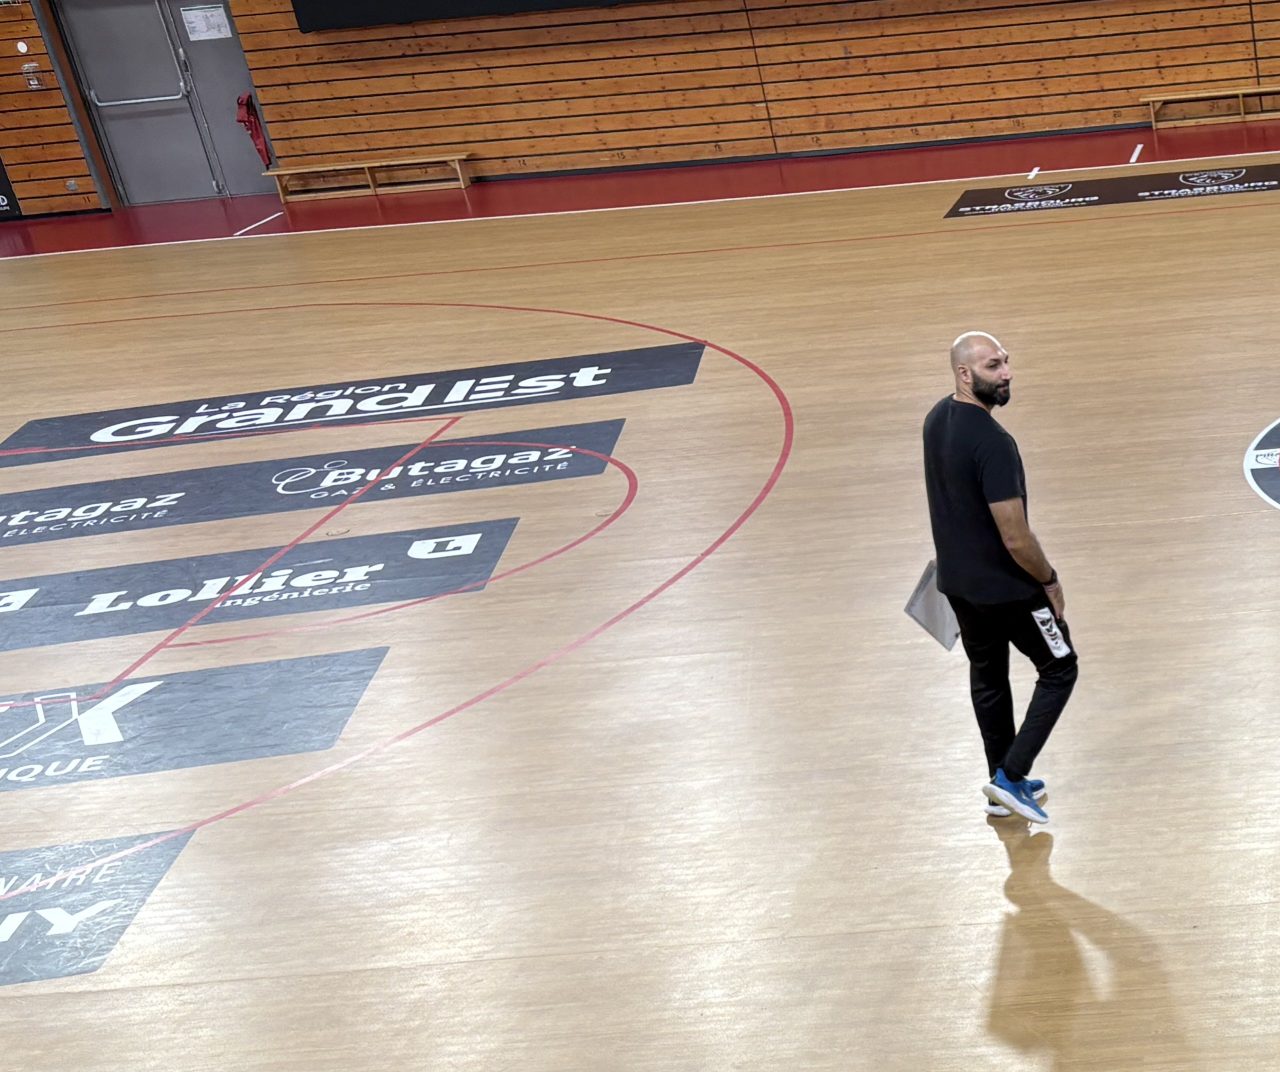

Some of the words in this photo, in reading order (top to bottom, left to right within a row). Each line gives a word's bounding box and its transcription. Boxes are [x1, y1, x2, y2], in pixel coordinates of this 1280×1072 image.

[90, 383, 436, 443] Grand
[443, 366, 612, 404] Est
[195, 401, 247, 414] La
[260, 382, 407, 407] Région
[320, 446, 574, 488] Butagaz
[410, 461, 569, 487] ÉLECTRICITÉ
[0, 492, 186, 526] tagaz
[74, 563, 385, 616] Lollier
[213, 582, 372, 609] ingénierie
